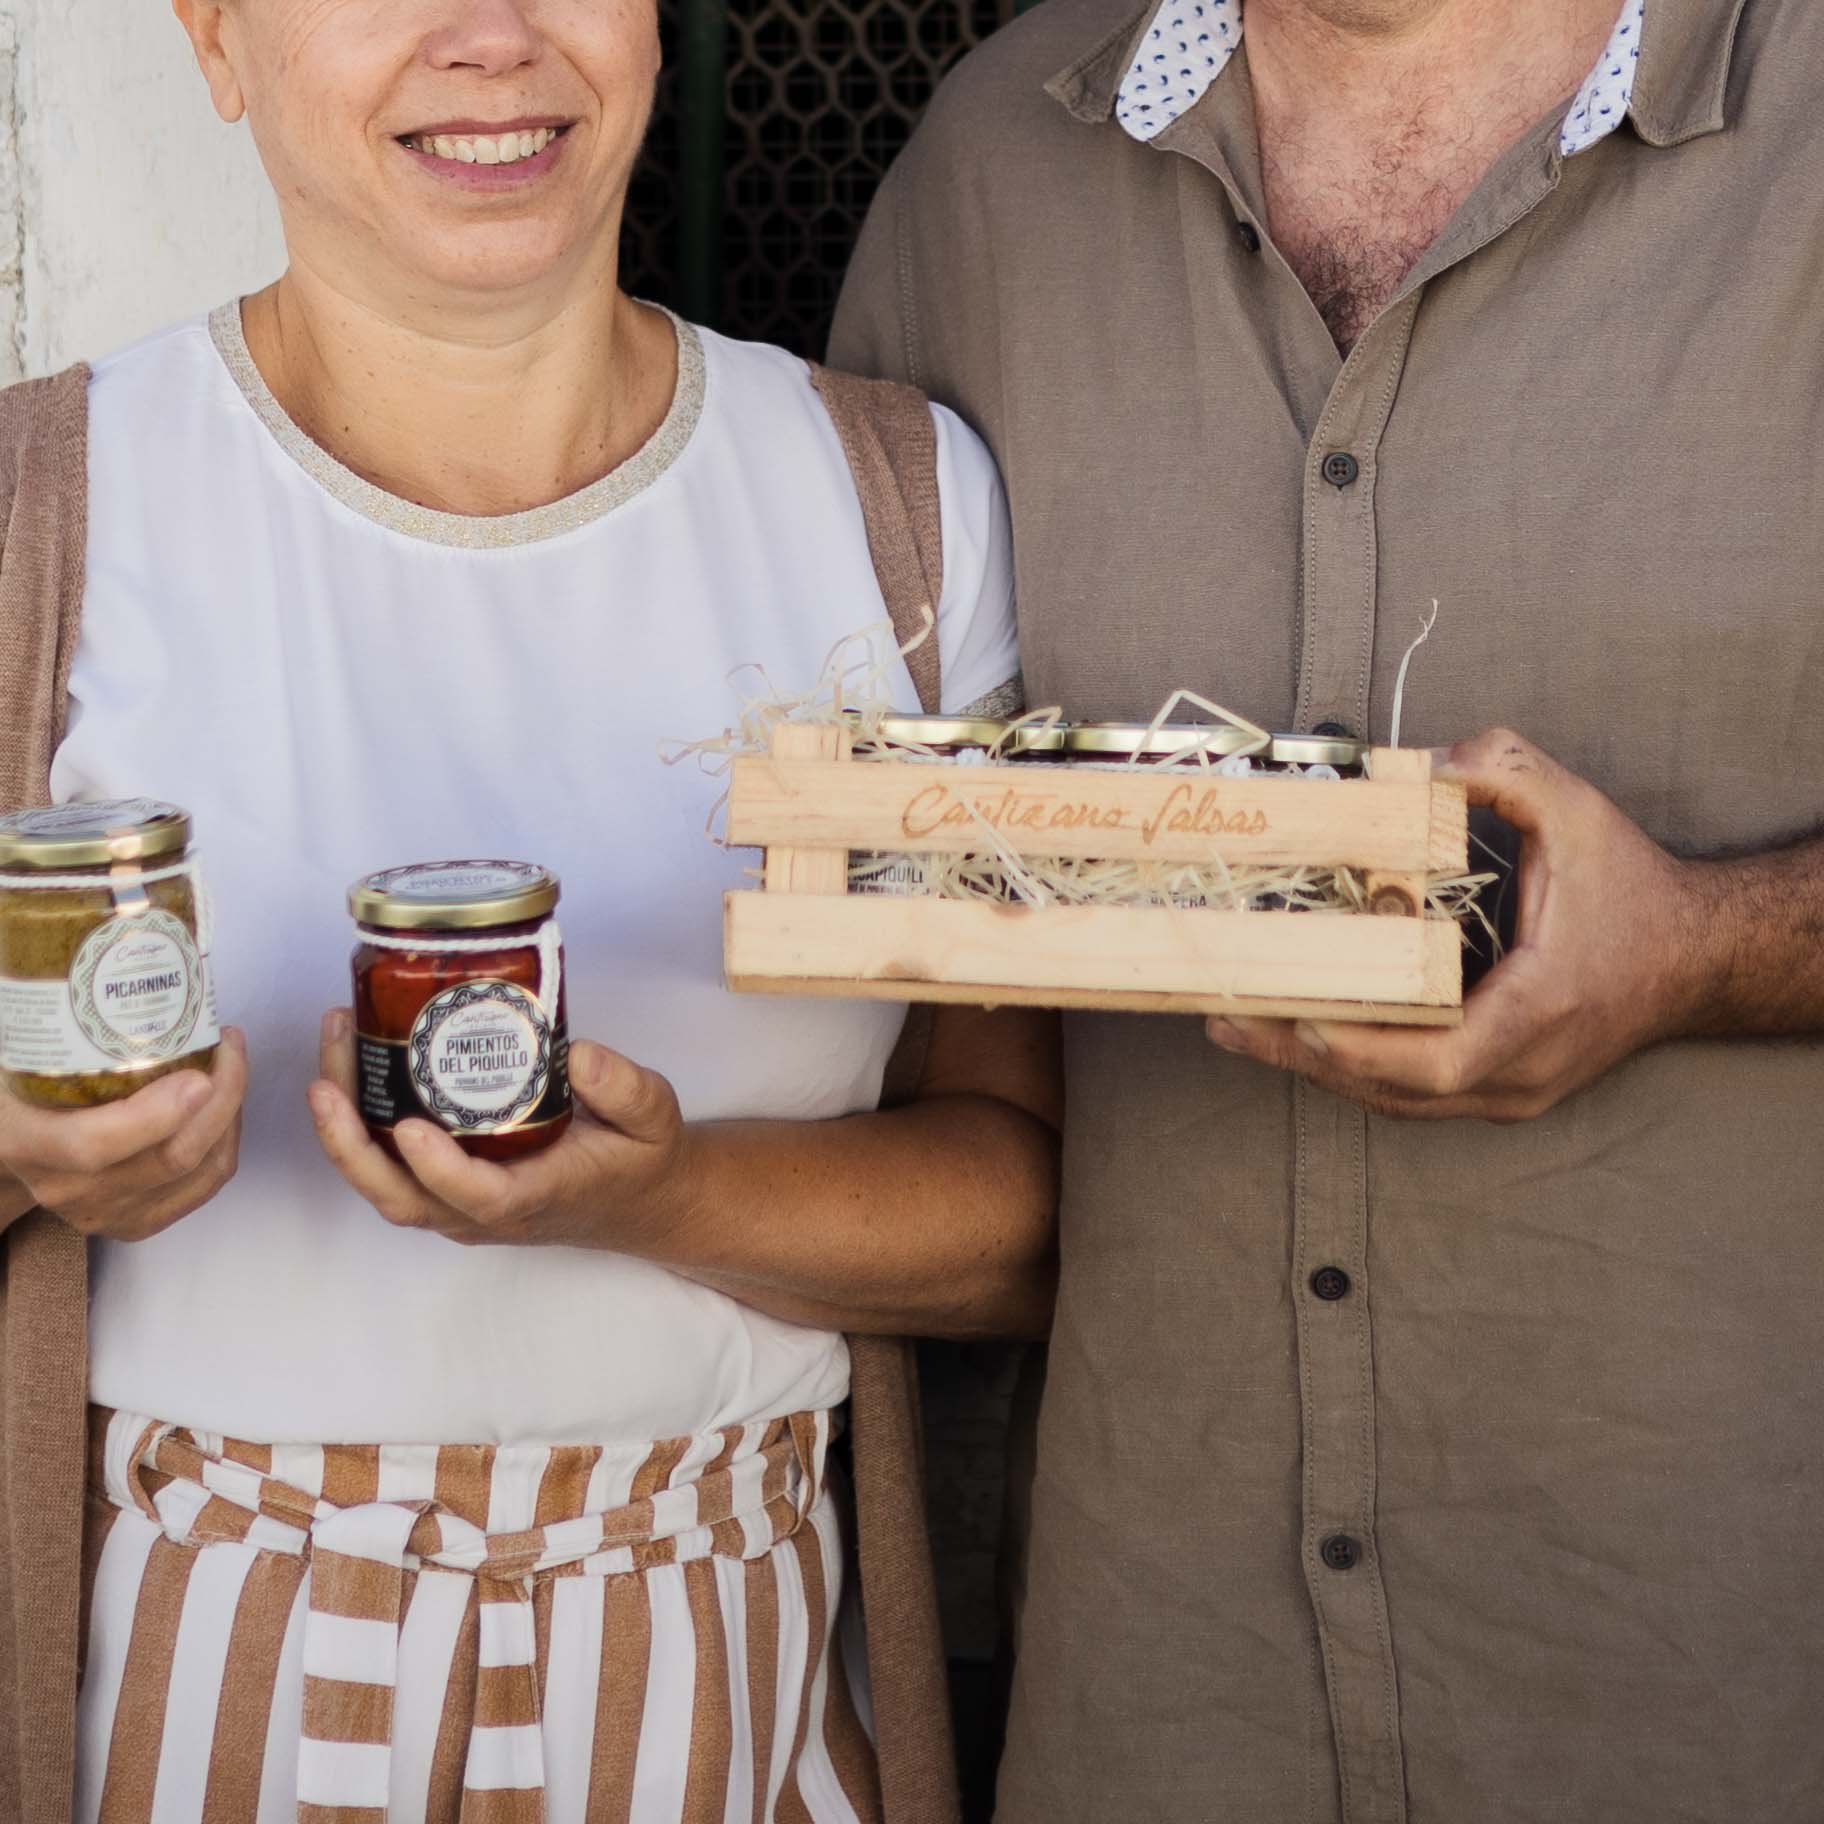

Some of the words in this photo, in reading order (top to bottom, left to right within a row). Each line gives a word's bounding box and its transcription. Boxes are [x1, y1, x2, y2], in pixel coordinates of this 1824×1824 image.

[901, 783, 1131, 839] Cantizano
[1142, 783, 1272, 846] Salsas
[105, 971, 182, 1000] PICARNINAS
[446, 1034, 519, 1056] PIMIENTOS
[439, 1057, 464, 1073] DEL
[469, 1051, 528, 1073] PIQUILLO
